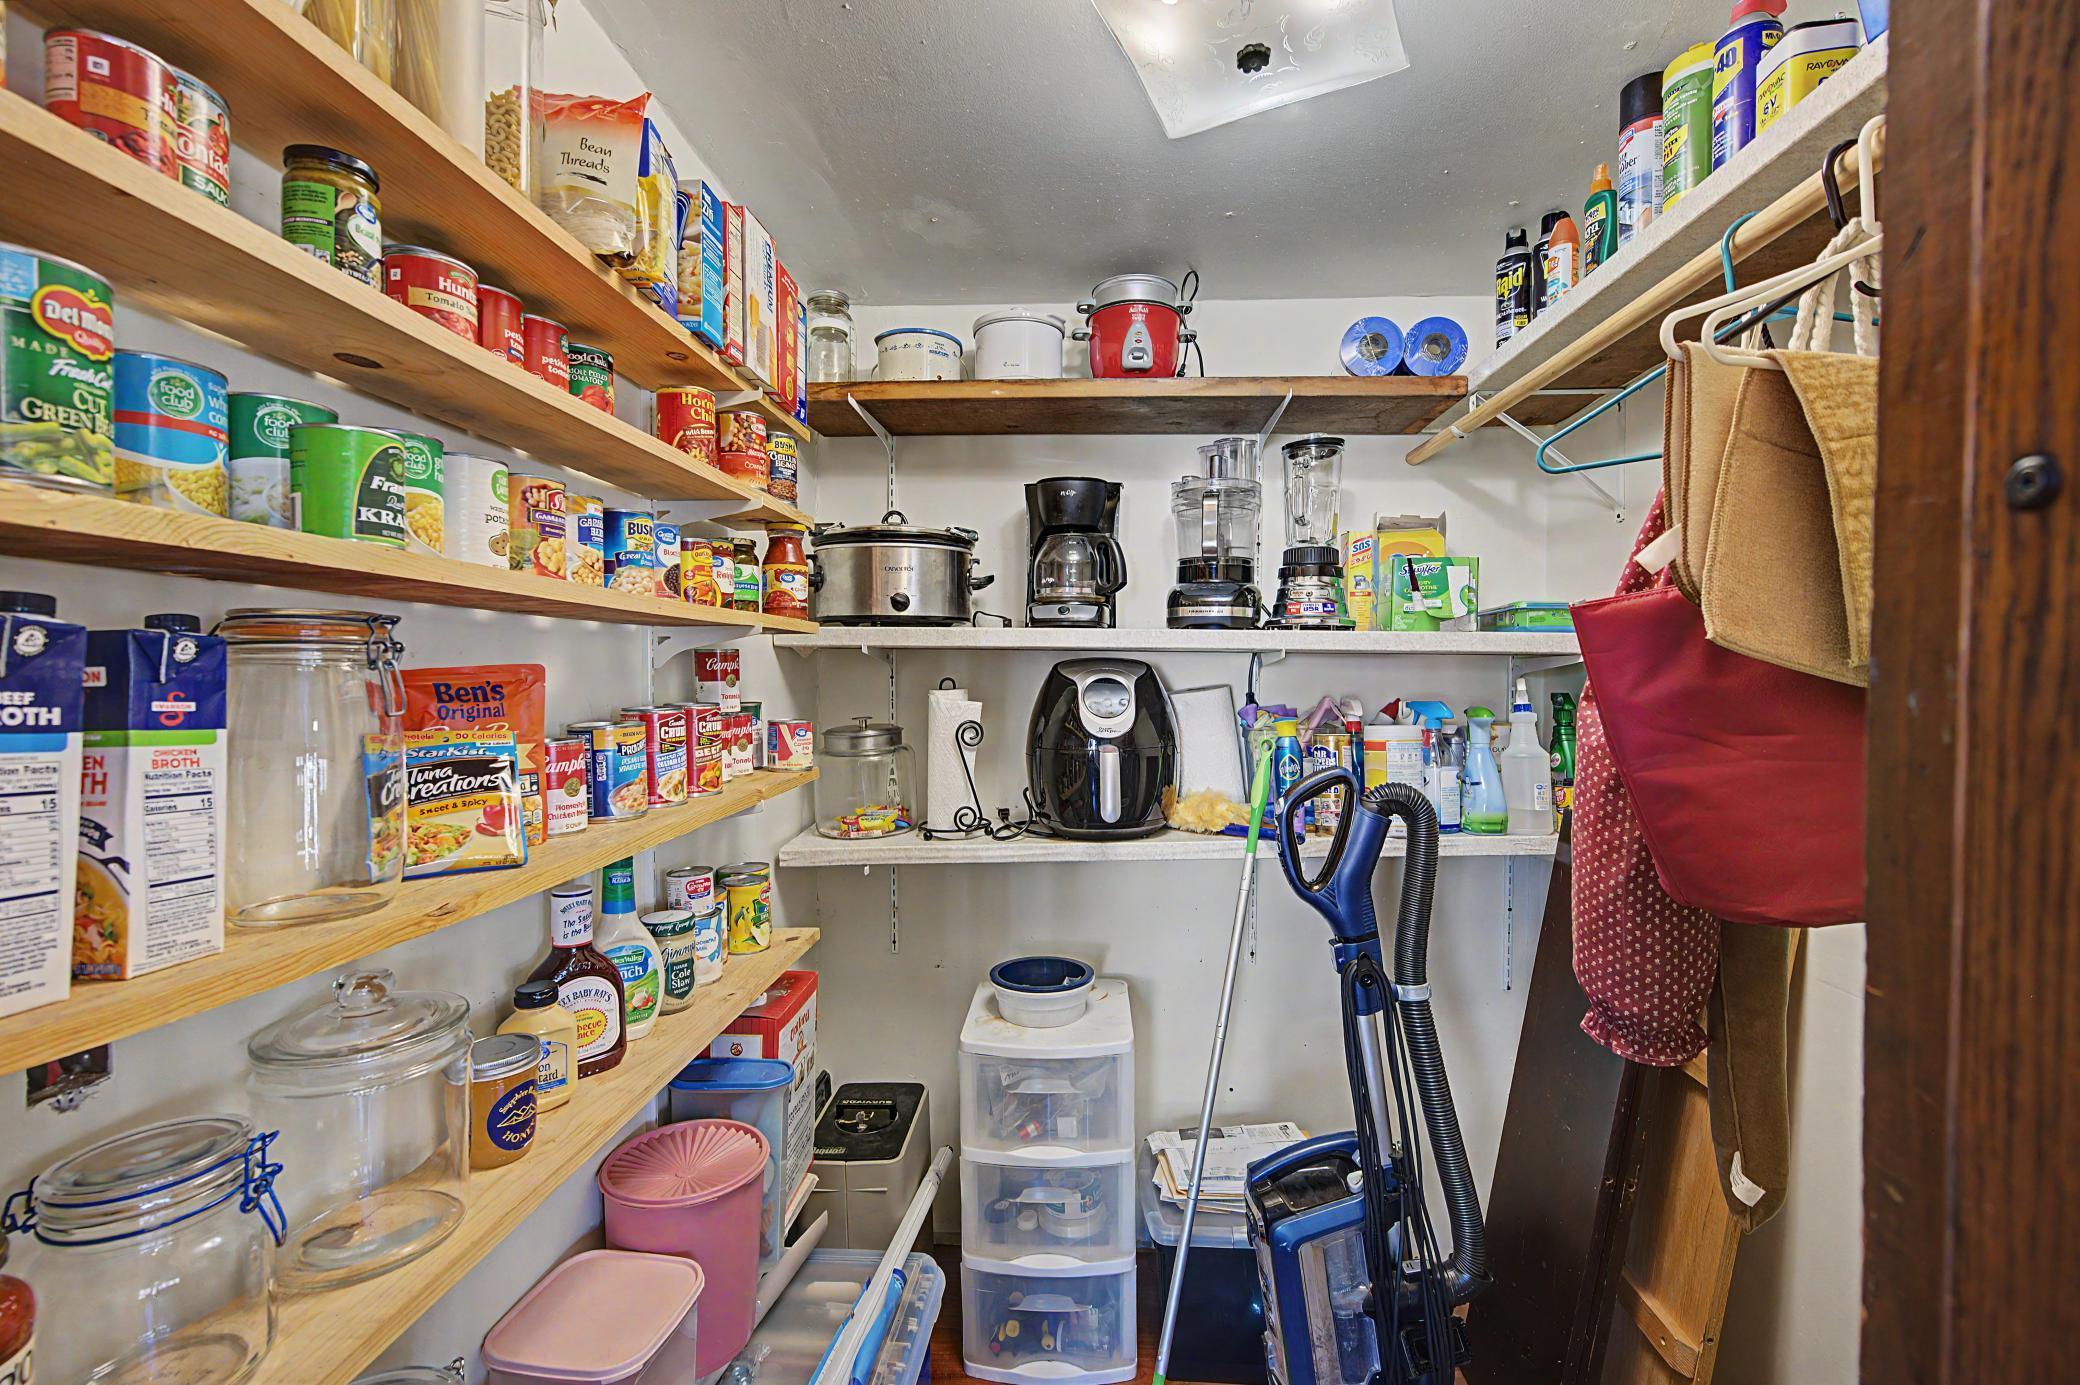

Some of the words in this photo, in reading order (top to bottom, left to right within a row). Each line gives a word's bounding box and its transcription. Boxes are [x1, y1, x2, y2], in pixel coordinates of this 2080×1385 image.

[579, 137, 613, 158] Bean
[560, 151, 611, 174] Threads
[425, 291, 465, 312] Tomato
[44, 299, 80, 327] Del
[9, 335, 69, 358] MADE
[160, 380, 195, 400] food
[72, 388, 107, 416] CUT
[161, 395, 194, 411] club
[20, 395, 95, 430] GREEN
[432, 680, 505, 704] Ben's
[437, 703, 506, 722] Original
[455, 732, 469, 740] 90
[471, 732, 507, 740] Calories
[153, 749, 198, 757] CHICKEN
[406, 745, 487, 759] StarKist
[23, 766, 58, 775] Facts
[152, 757, 201, 770] BROTH
[144, 771, 183, 781] Nutrition
[185, 770, 213, 779] Facts
[410, 764, 452, 785] Tuna
[41, 798, 57, 810] 15
[201, 798, 213, 808] 15
[461, 798, 488, 809] Spicy
[671, 967, 691, 980] Cole
[671, 978, 690, 989] Slaw
[571, 989, 593, 1000] BABY
